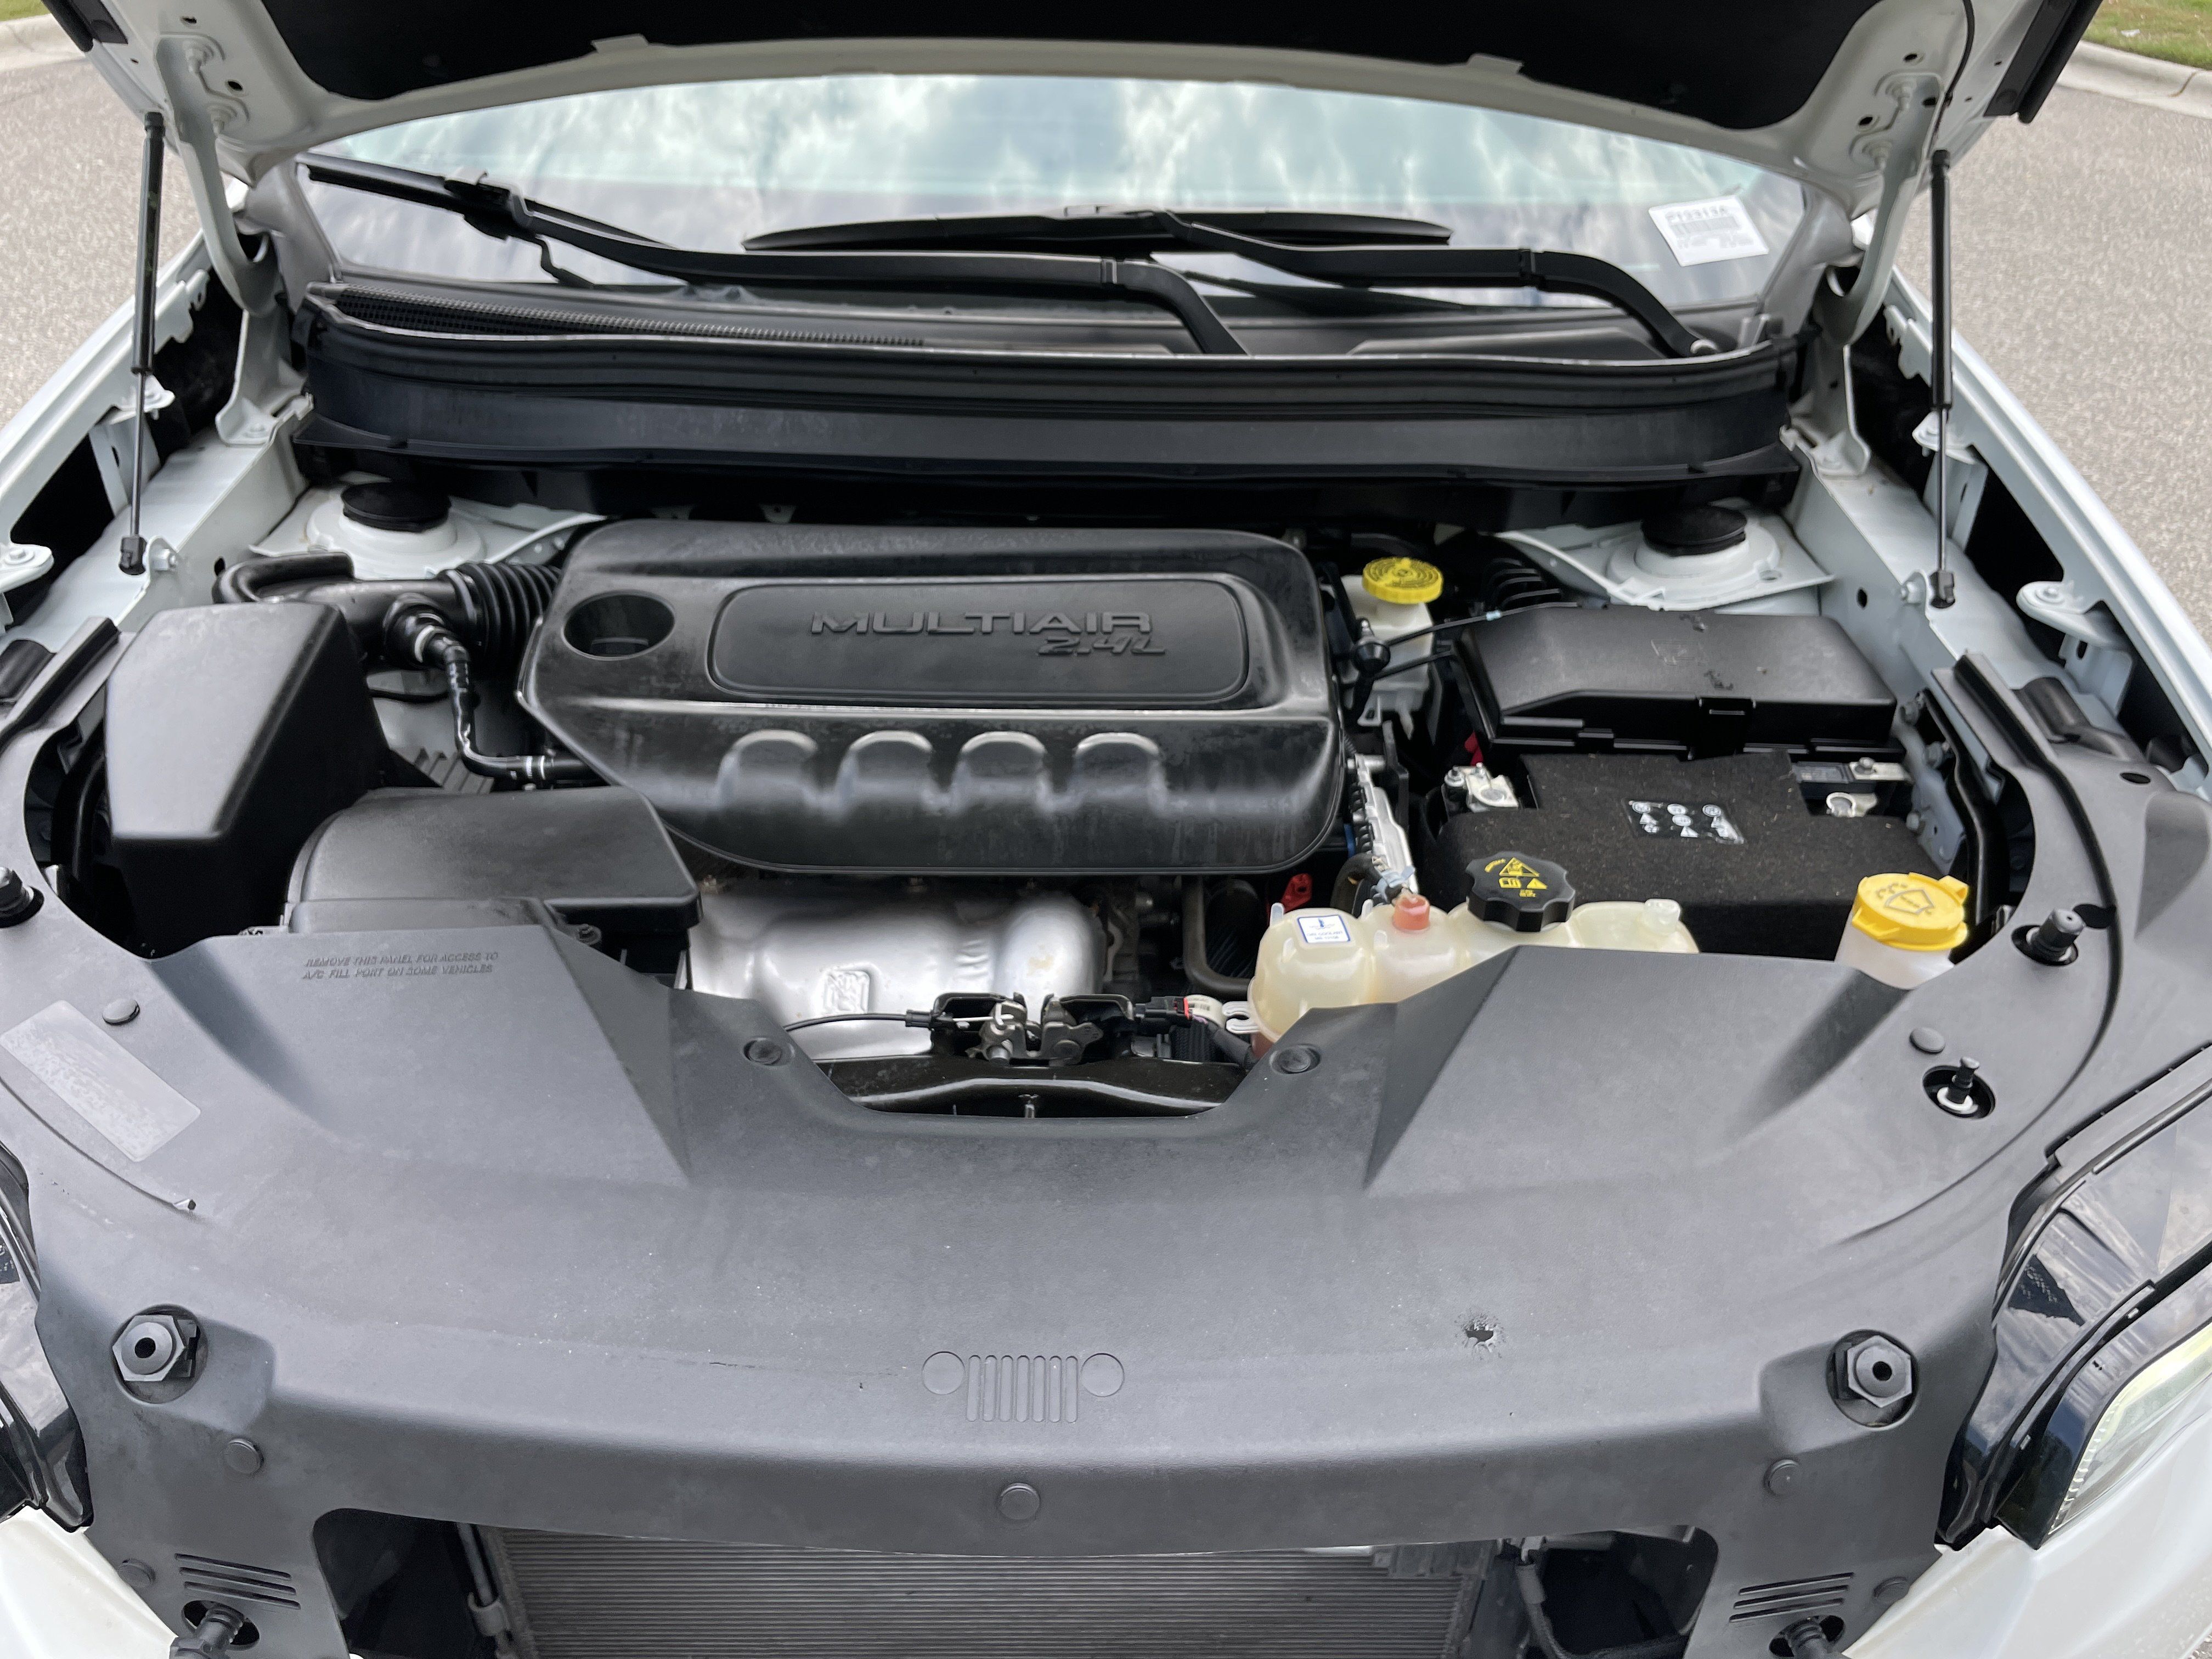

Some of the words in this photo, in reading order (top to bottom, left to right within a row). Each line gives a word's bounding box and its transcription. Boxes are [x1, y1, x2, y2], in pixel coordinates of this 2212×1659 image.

[811, 611, 1150, 634] MULTIAIR
[1037, 635, 1166, 655] 2.4L
[305, 956, 351, 967] REMOVE
[354, 956, 377, 966] THIS
[380, 955, 411, 964] PANEL
[416, 953, 438, 963] FOR
[439, 952, 482, 962] ACCESS
[486, 952, 499, 961] TO
[329, 969, 350, 979] FILL
[354, 967, 385, 978] PORT
[387, 966, 404, 977] ON
[406, 965, 438, 975] SOME
[443, 963, 494, 975] VEHICLES
